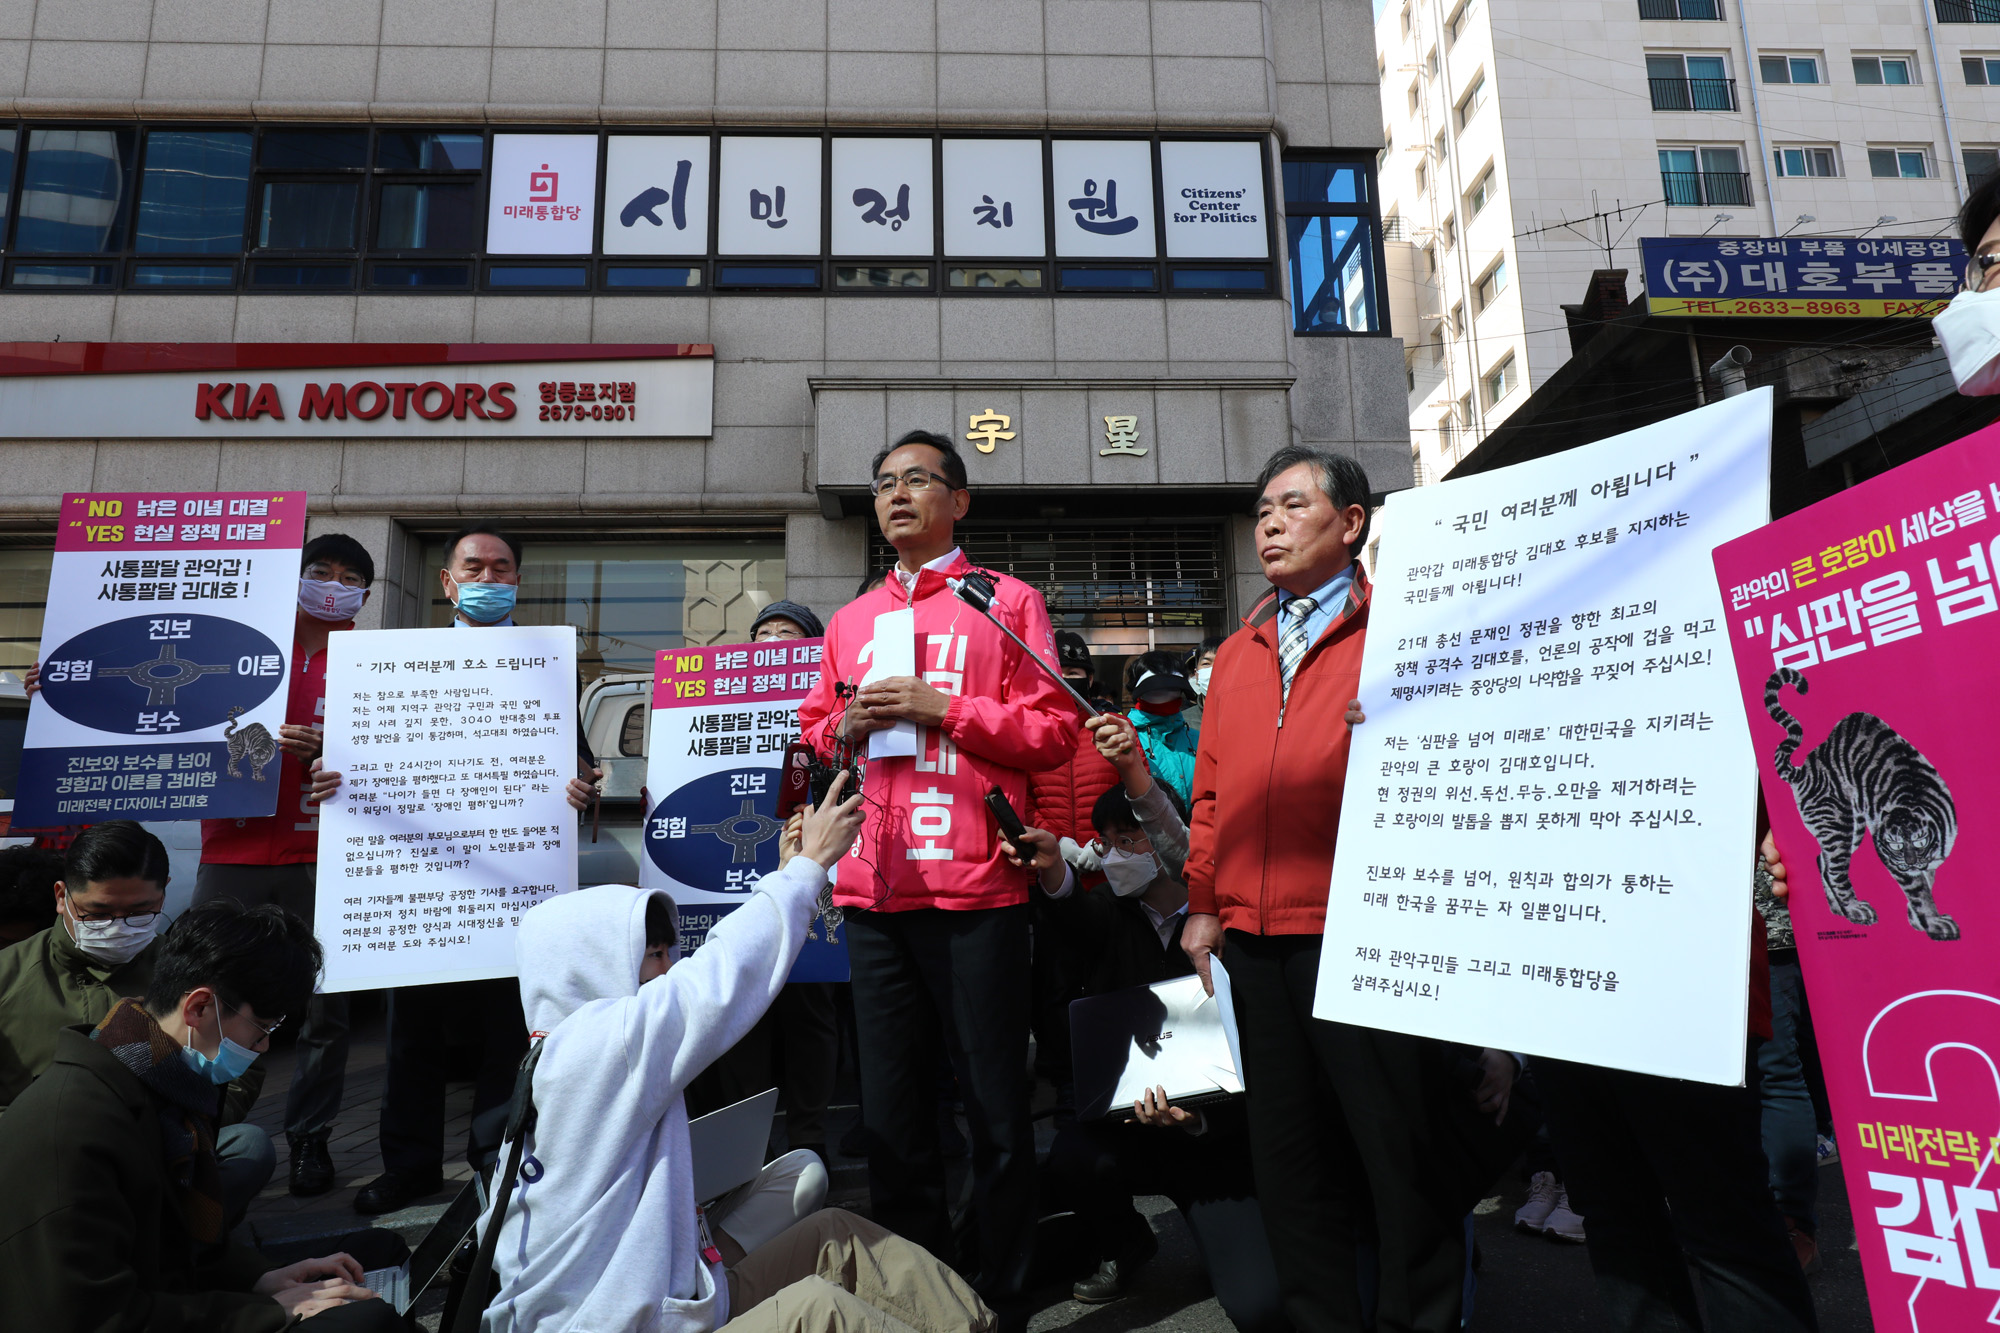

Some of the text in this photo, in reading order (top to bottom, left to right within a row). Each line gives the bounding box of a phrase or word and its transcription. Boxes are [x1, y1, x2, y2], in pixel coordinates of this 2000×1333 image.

[1180, 186, 1247, 199] Citizens'
[503, 203, 581, 221] 미래통합당
[1188, 199, 1242, 212] Center
[1173, 212, 1258, 225] for Politics
[1718, 241, 1788, 257] 중장비
[1799, 241, 1846, 257] 부품
[1857, 241, 1950, 257] 아세공업
[1682, 300, 1861, 315] TEL.2633-8963
[194, 380, 517, 421] KIA MOTORS
[538, 382, 636, 403] 영등포지점
[538, 403, 636, 422] 2679-0301
[137, 499, 177, 517] 낡은
[183, 498, 223, 518] 이념
[1452, 460, 1677, 535] 국민 여러분께 아룁니다
[134, 524, 174, 542] 현실
[180, 523, 220, 542] 정책
[1406, 510, 1690, 582] 관악갑 미래통합당 김대호 후보를 지지하는
[1730, 568, 1789, 612] 관악의
[1791, 561, 1817, 590] 큰
[1818, 525, 1897, 574] 호랑이
[1900, 488, 1987, 549] 세상을
[101, 559, 181, 579] 사통팔달
[97, 582, 178, 601] 사통팔달
[1403, 572, 1522, 605] 국민들께 아룁니다!
[148, 619, 191, 640] 진보
[1397, 599, 1657, 651] 21대 총선 문재인 정권을 향한 최고의
[1394, 618, 1717, 678] 정책 공격수 김대호를, 언론의 공작에 겁을 먹고
[238, 655, 281, 677] 이론
[370, 656, 547, 674] 기자 여러분께 호소 드립니다
[715, 651, 748, 670] 낡은
[754, 649, 787, 667] 이념
[48, 660, 93, 682] 경험
[352, 687, 493, 702] 저는 참으로 부족한 사람입니다.
[714, 676, 747, 696] 현실
[752, 674, 786, 693] 정책
[352, 706, 371, 716] 저는
[376, 704, 395, 714] 어제
[400, 703, 429, 714] 지역구
[466, 700, 495, 712] 구민과
[499, 700, 518, 711] 국민
[522, 699, 541, 710] 앞에
[135, 711, 181, 733] 보수
[351, 720, 371, 730] 저의
[404, 717, 423, 729] 깊지
[429, 716, 452, 728] 못한,
[460, 714, 492, 725] 3040
[499, 713, 536, 725] 반대층의
[542, 712, 561, 722] 투표
[689, 713, 753, 733] 사통팔달
[687, 735, 752, 756] 사통팔달
[67, 752, 211, 774] 진보와 보수를 넘어
[349, 754, 546, 773] 그리고 만 24시간이 지나기도 전, 여러분은
[1380, 752, 1595, 777] 관악의 큰 호랑이 김대호입니다.
[56, 772, 217, 793] 경험과 이론을 겸비한
[730, 774, 767, 796] 진보
[58, 794, 208, 813] 미래전략 디자이너 김대호
[651, 817, 687, 840] 경험
[1373, 808, 1702, 831] 큰 호랑이의 발톱을 뽑지 못하게 막아 주십시오.
[724, 870, 761, 891] 보수
[1366, 865, 1674, 895] 진보와 보수를 넘어, 원칙과 합의가 통하는
[343, 896, 362, 908] 여러
[367, 893, 404, 906] 기자들께
[448, 888, 477, 902] 공정한
[480, 886, 508, 898] 기사를
[510, 883, 560, 896] 요구합니다.
[341, 934, 471, 954] 기자 여러분 도와 주십시오!
[1351, 974, 1440, 1001] 살려주십시오!
[1145, 1031, 1172, 1042] ASUS
[1857, 1122, 1981, 1172] 미래전략
